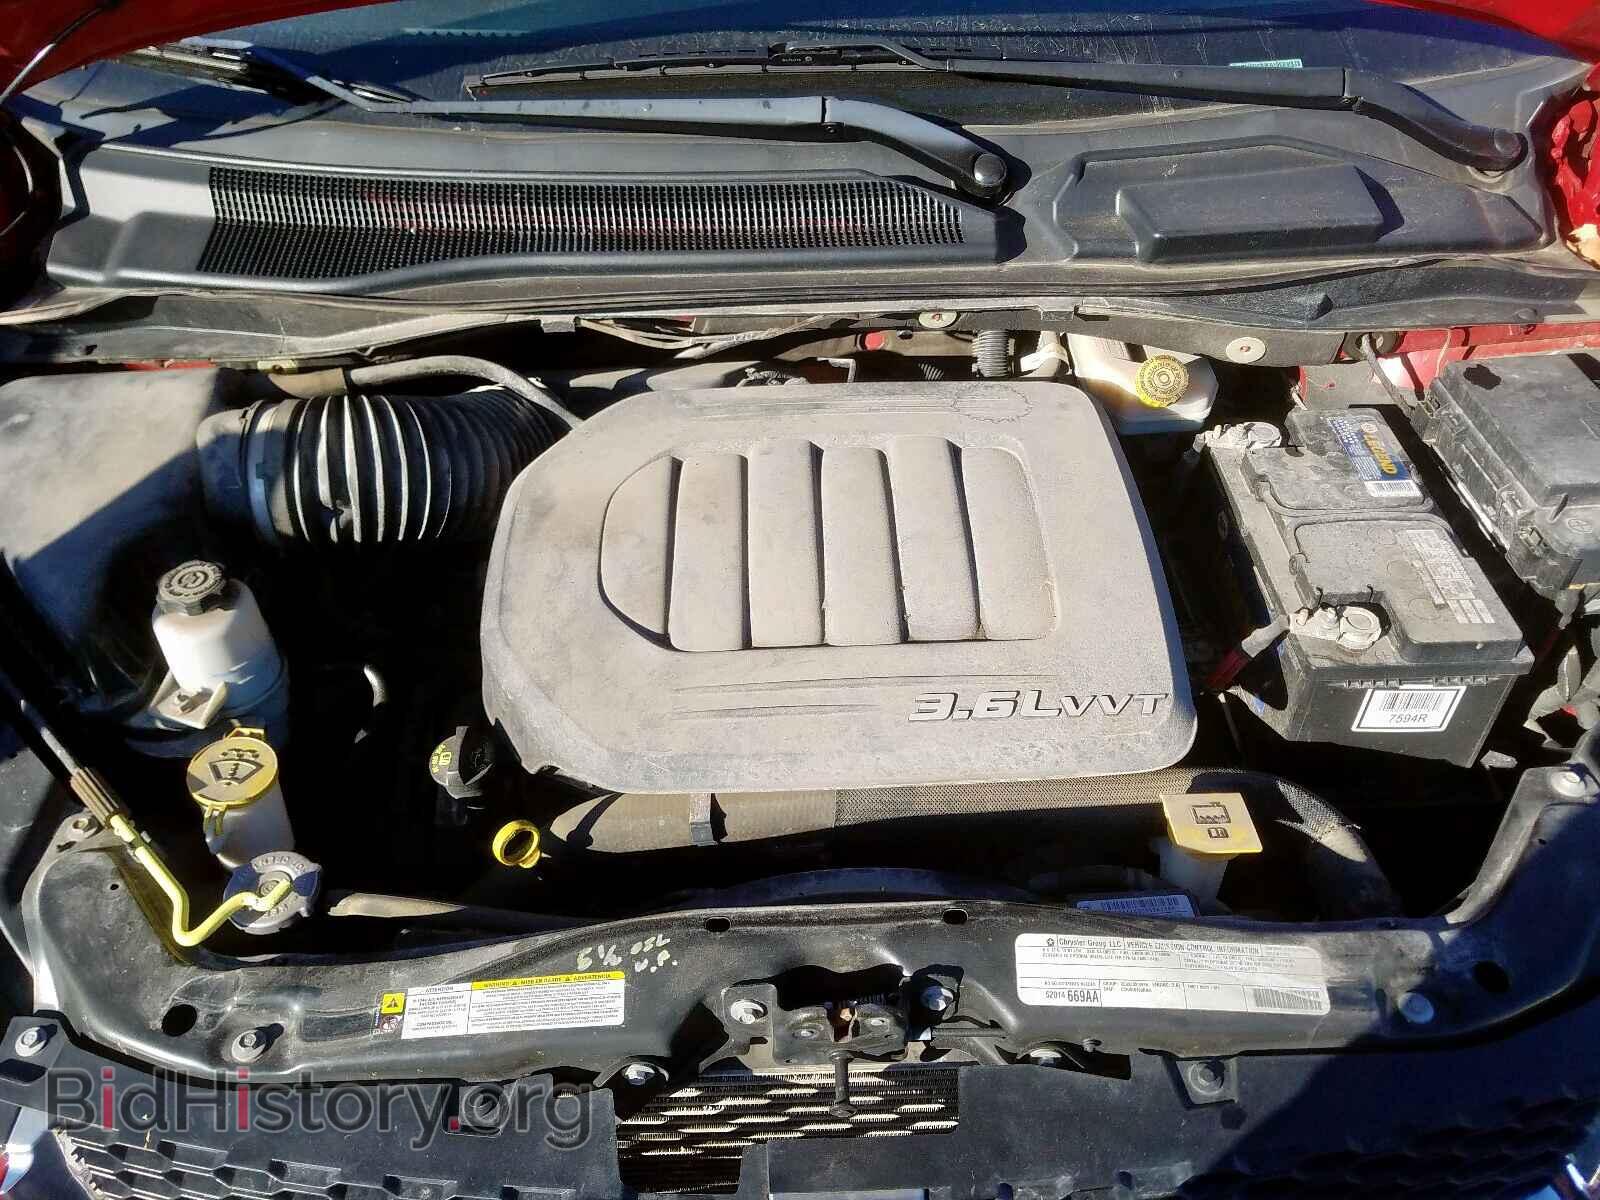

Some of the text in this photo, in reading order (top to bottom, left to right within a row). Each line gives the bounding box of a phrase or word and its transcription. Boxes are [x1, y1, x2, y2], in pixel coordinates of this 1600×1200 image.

[1389, 713, 1428, 723] 7594R
[1058, 938, 1085, 947] Chrysler
[1087, 939, 1107, 949] Group
[1067, 990, 1099, 1003] 669AA
